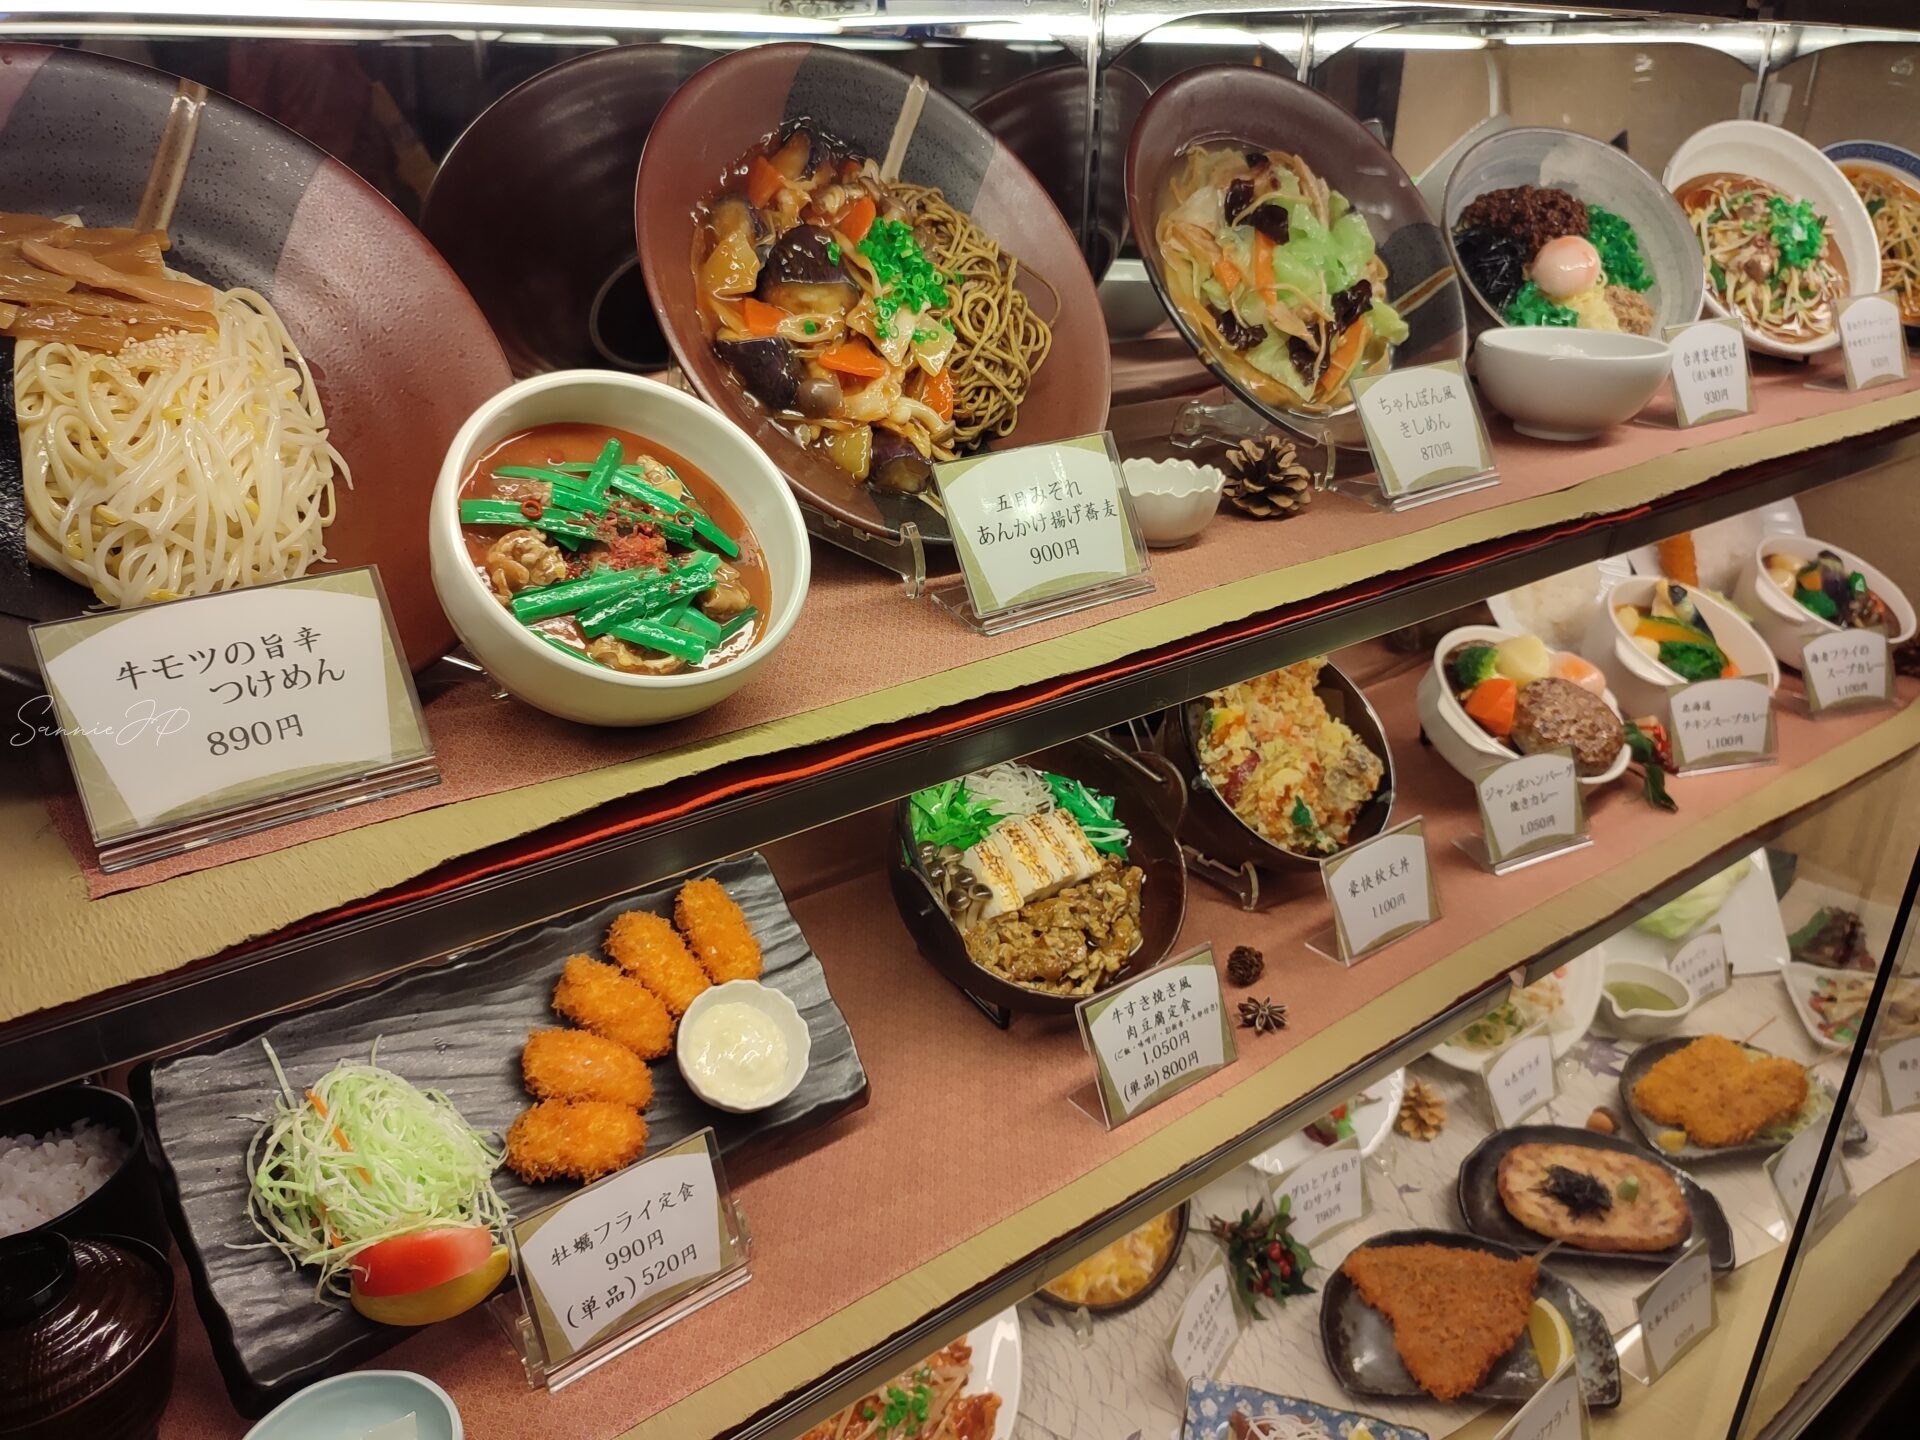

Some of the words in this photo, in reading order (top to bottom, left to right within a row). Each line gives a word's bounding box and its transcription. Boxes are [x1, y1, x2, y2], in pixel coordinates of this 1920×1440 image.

[1378, 385, 1456, 415] ちゃんぽん風
[1703, 388, 1728, 405] 930円
[1400, 414, 1450, 439] きしめん
[1420, 441, 1453, 461] 870円
[996, 479, 1083, 513] 五目みぞれ
[977, 498, 1119, 546] あんかけ揚げ蕎麦
[1030, 538, 1080, 565] 900円
[116, 626, 322, 690] 牛モツの旨辛
[1827, 662, 1885, 679] スープカレー
[209, 658, 346, 705] つけめん
[207, 714, 305, 757] 890円
[1485, 763, 1573, 802] ジャンボハンバーグ
[1510, 791, 1559, 813] 焼きカレー
[1348, 856, 1410, 898] 豪快秋天丼
[1371, 892, 1407, 918] 1100円
[1112, 976, 1192, 1025] 牛すき焼き風
[1126, 998, 1192, 1041] 肉豆腐定食
[1142, 1030, 1191, 1066] 1,050円
[1291, 1156, 1357, 1199] グロとアボカド
[551, 1181, 695, 1267] 牡蠣フライ定食
[605, 1229, 665, 1271] 990円
